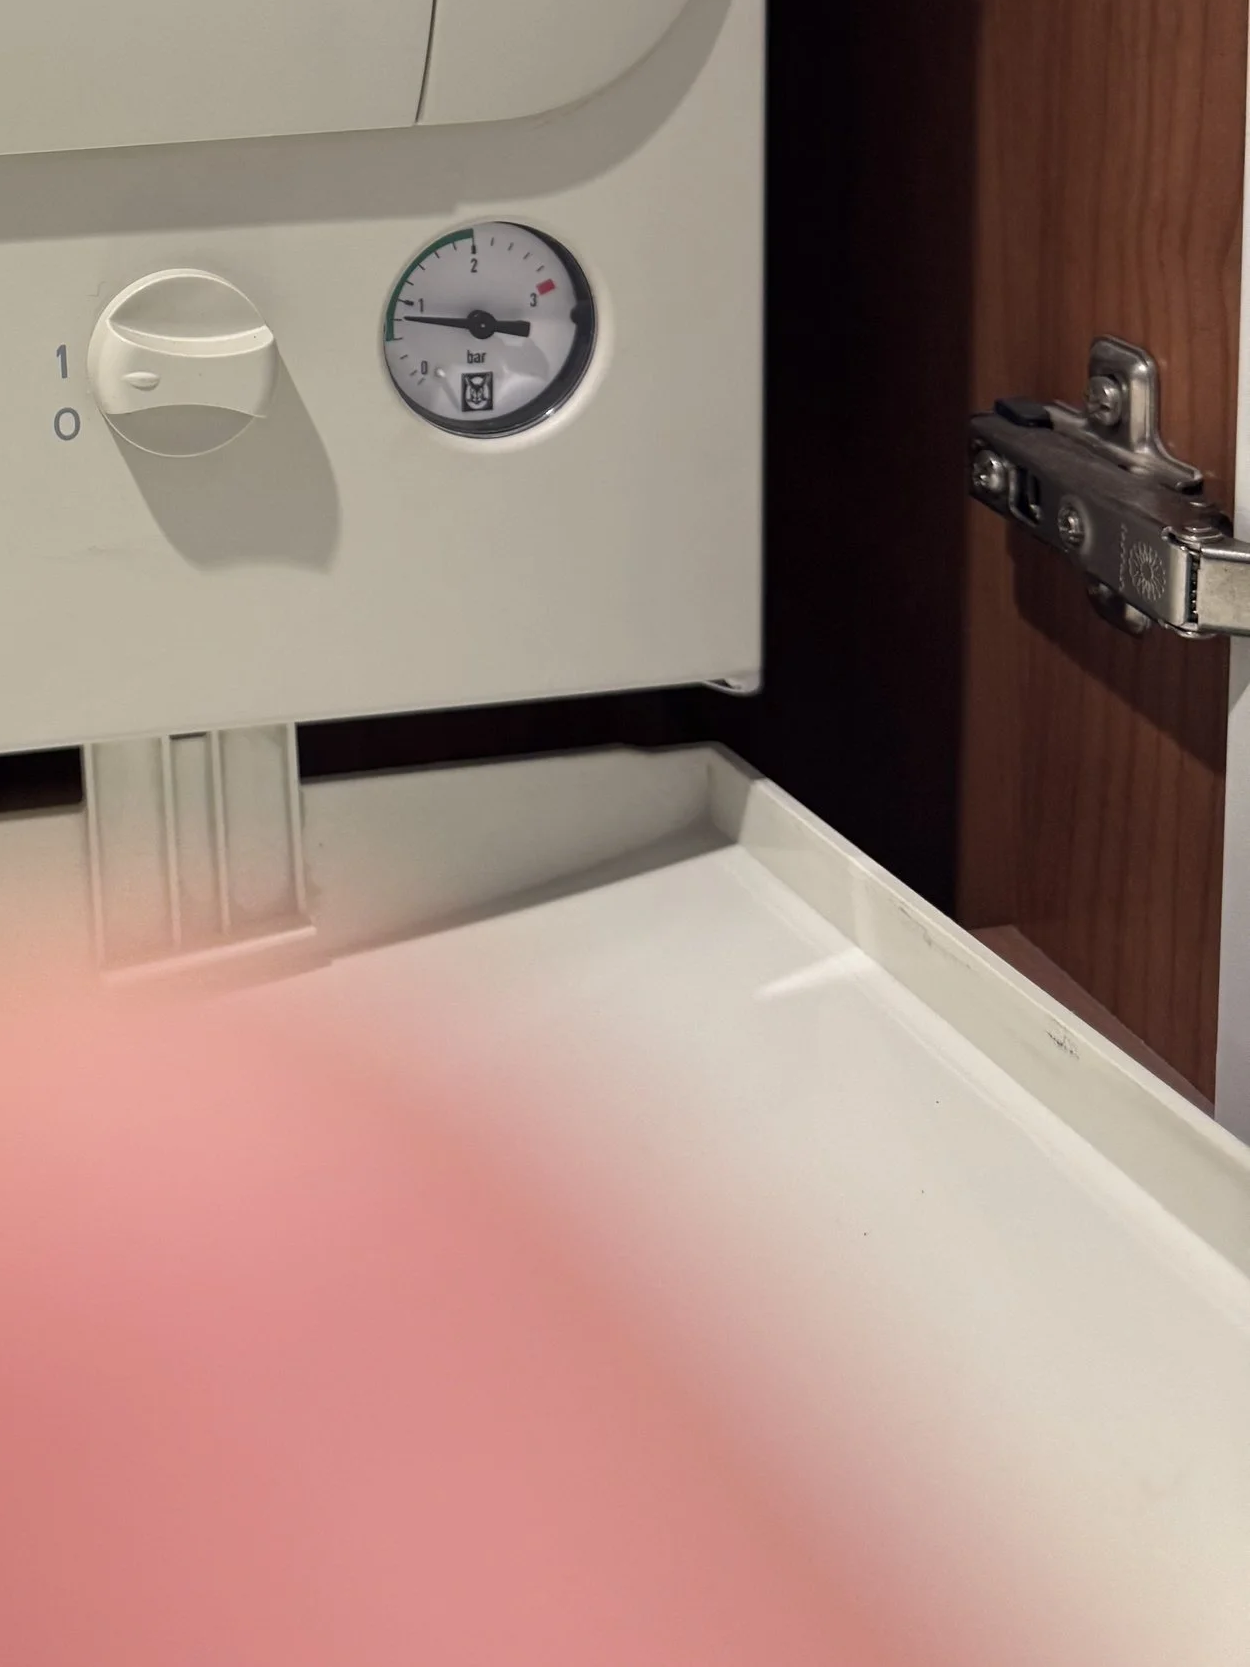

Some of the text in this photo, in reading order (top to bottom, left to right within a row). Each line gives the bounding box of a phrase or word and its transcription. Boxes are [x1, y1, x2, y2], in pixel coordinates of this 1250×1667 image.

[470, 258, 478, 273] 2
[417, 298, 425, 314] 1
[529, 292, 538, 308] 3
[56, 344, 68, 379] 1
[466, 349, 487, 364] bar
[420, 360, 429, 376] 0
[53, 407, 81, 441] 0
